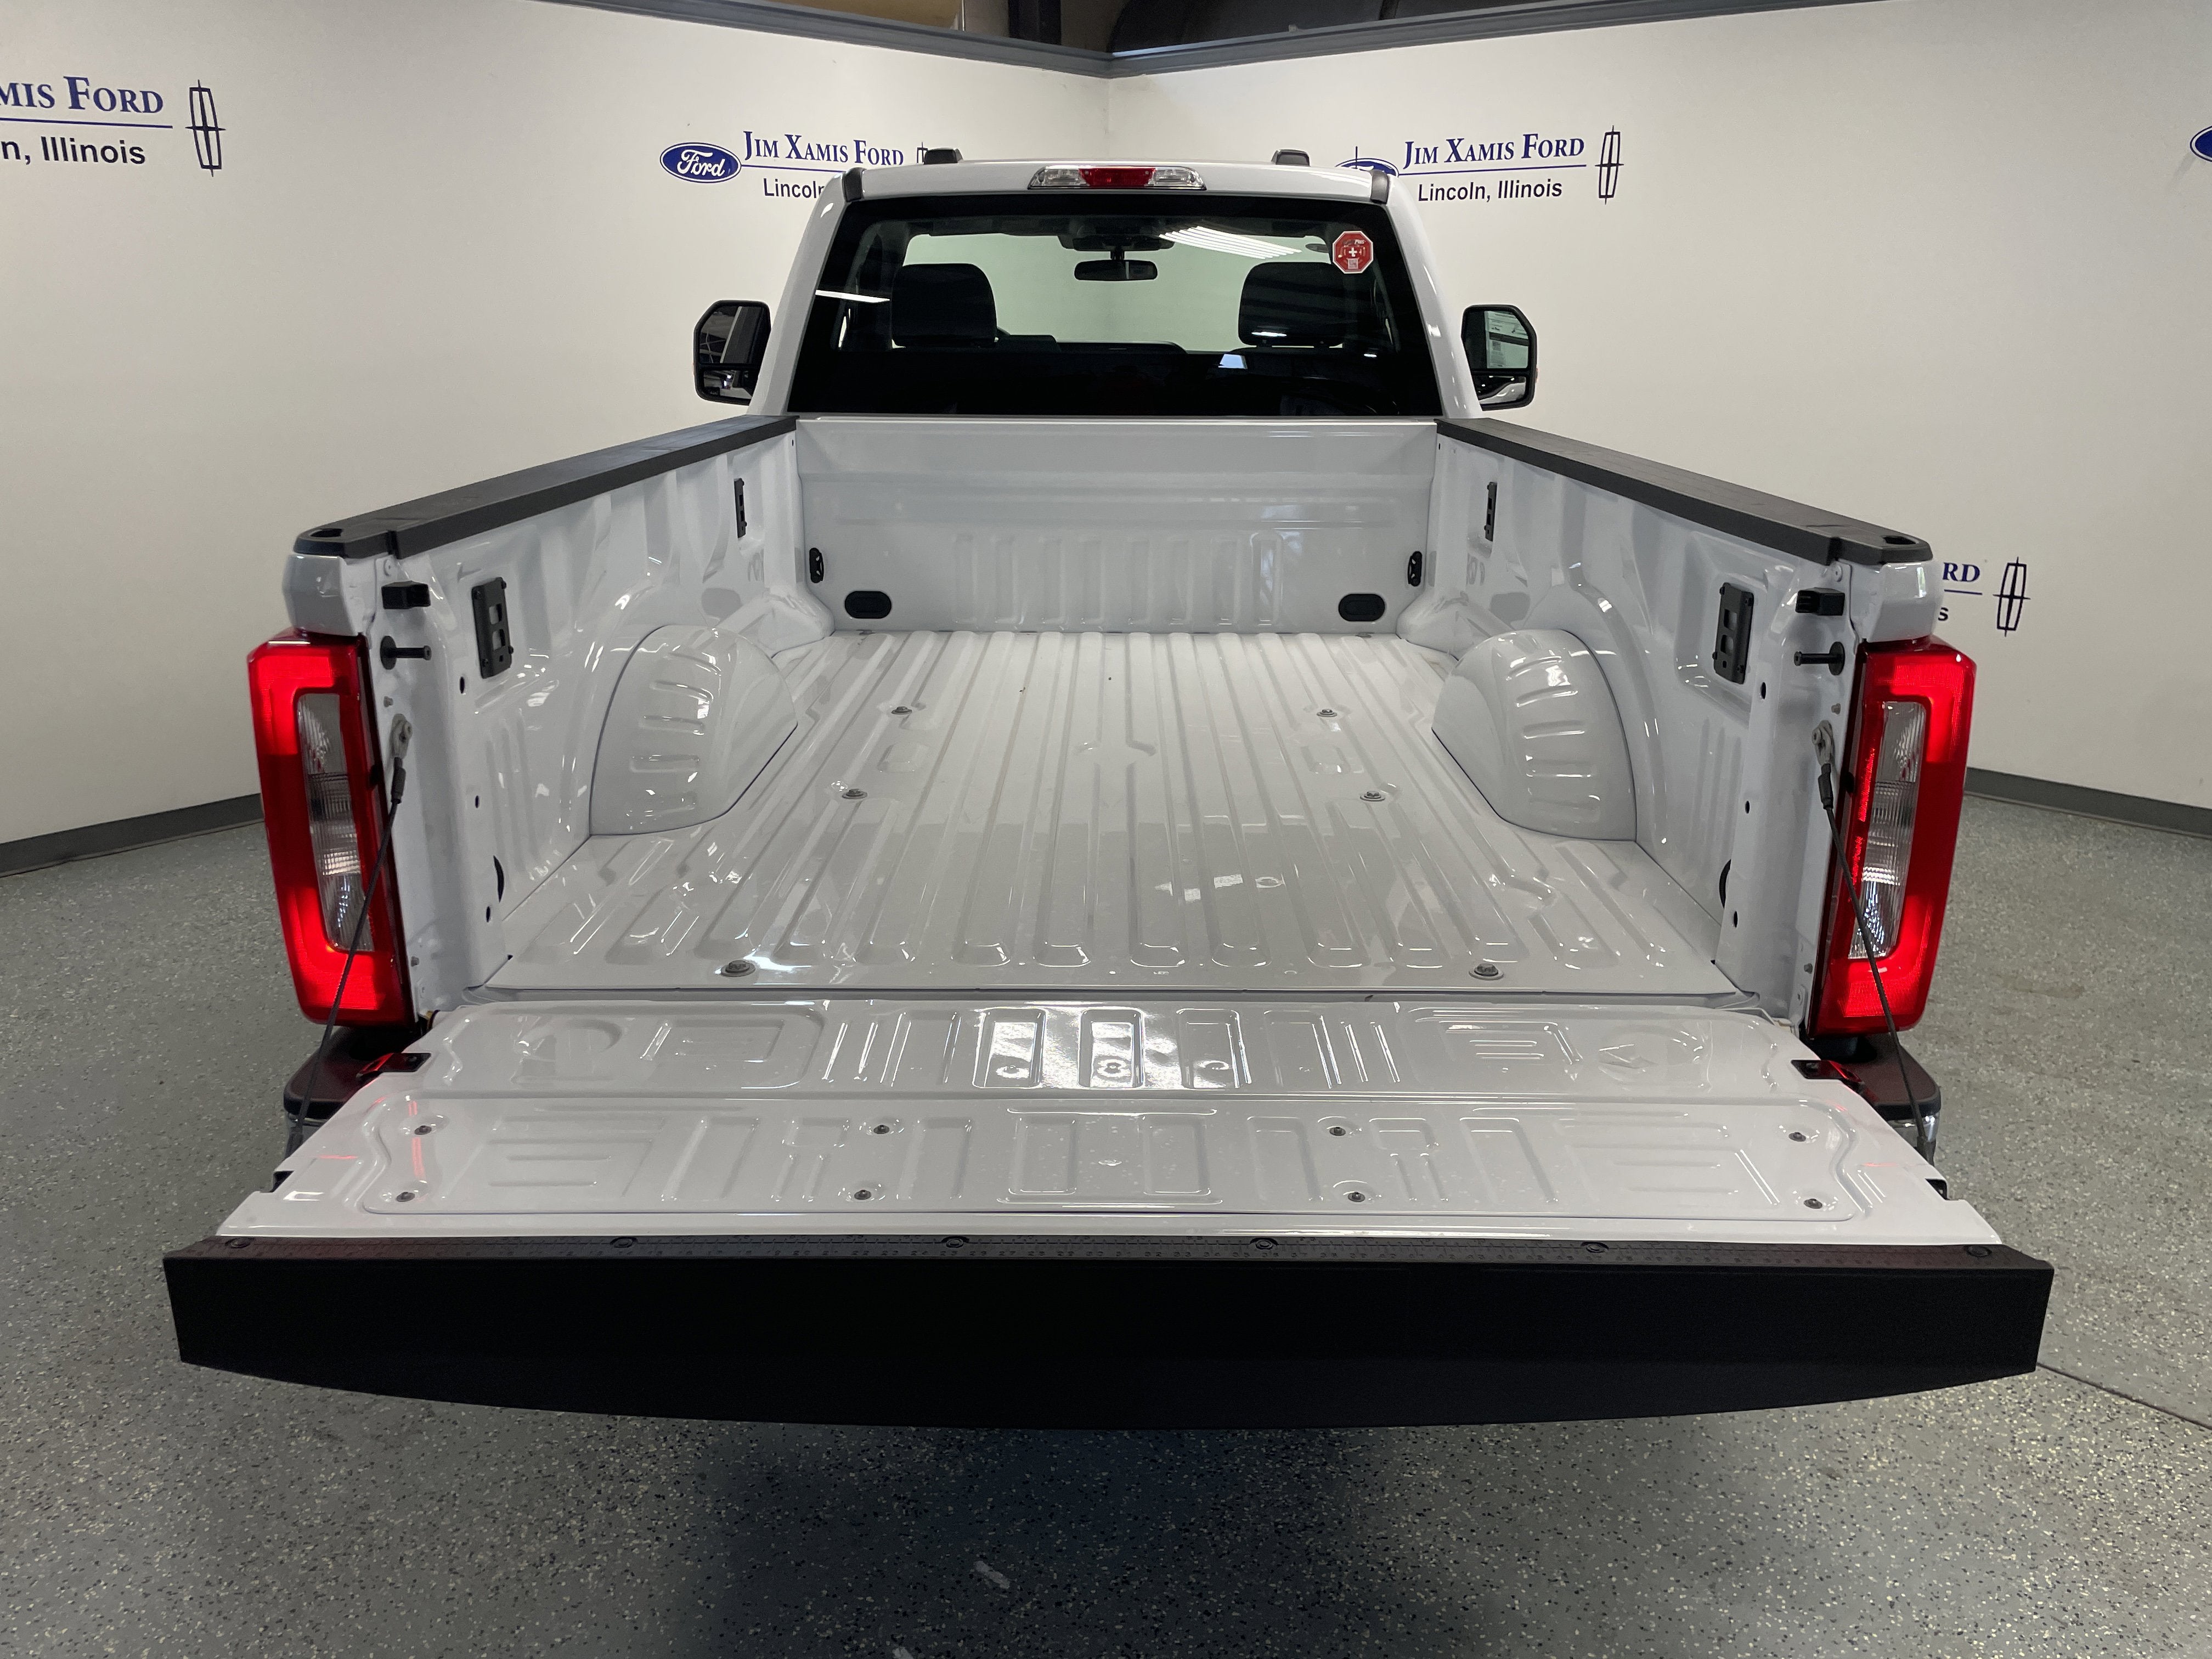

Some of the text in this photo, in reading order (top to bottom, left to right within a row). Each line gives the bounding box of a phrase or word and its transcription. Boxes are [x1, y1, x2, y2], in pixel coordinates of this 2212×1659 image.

[0, 76, 163, 114] MIS FORD
[41, 136, 145, 165] Illinois
[677, 149, 725, 177] Ford
[743, 131, 904, 166] JIM XAMIS FORD
[1402, 133, 1585, 170] JIM XAMIS FORD
[1418, 178, 1562, 202] Lincoln, Illinois
